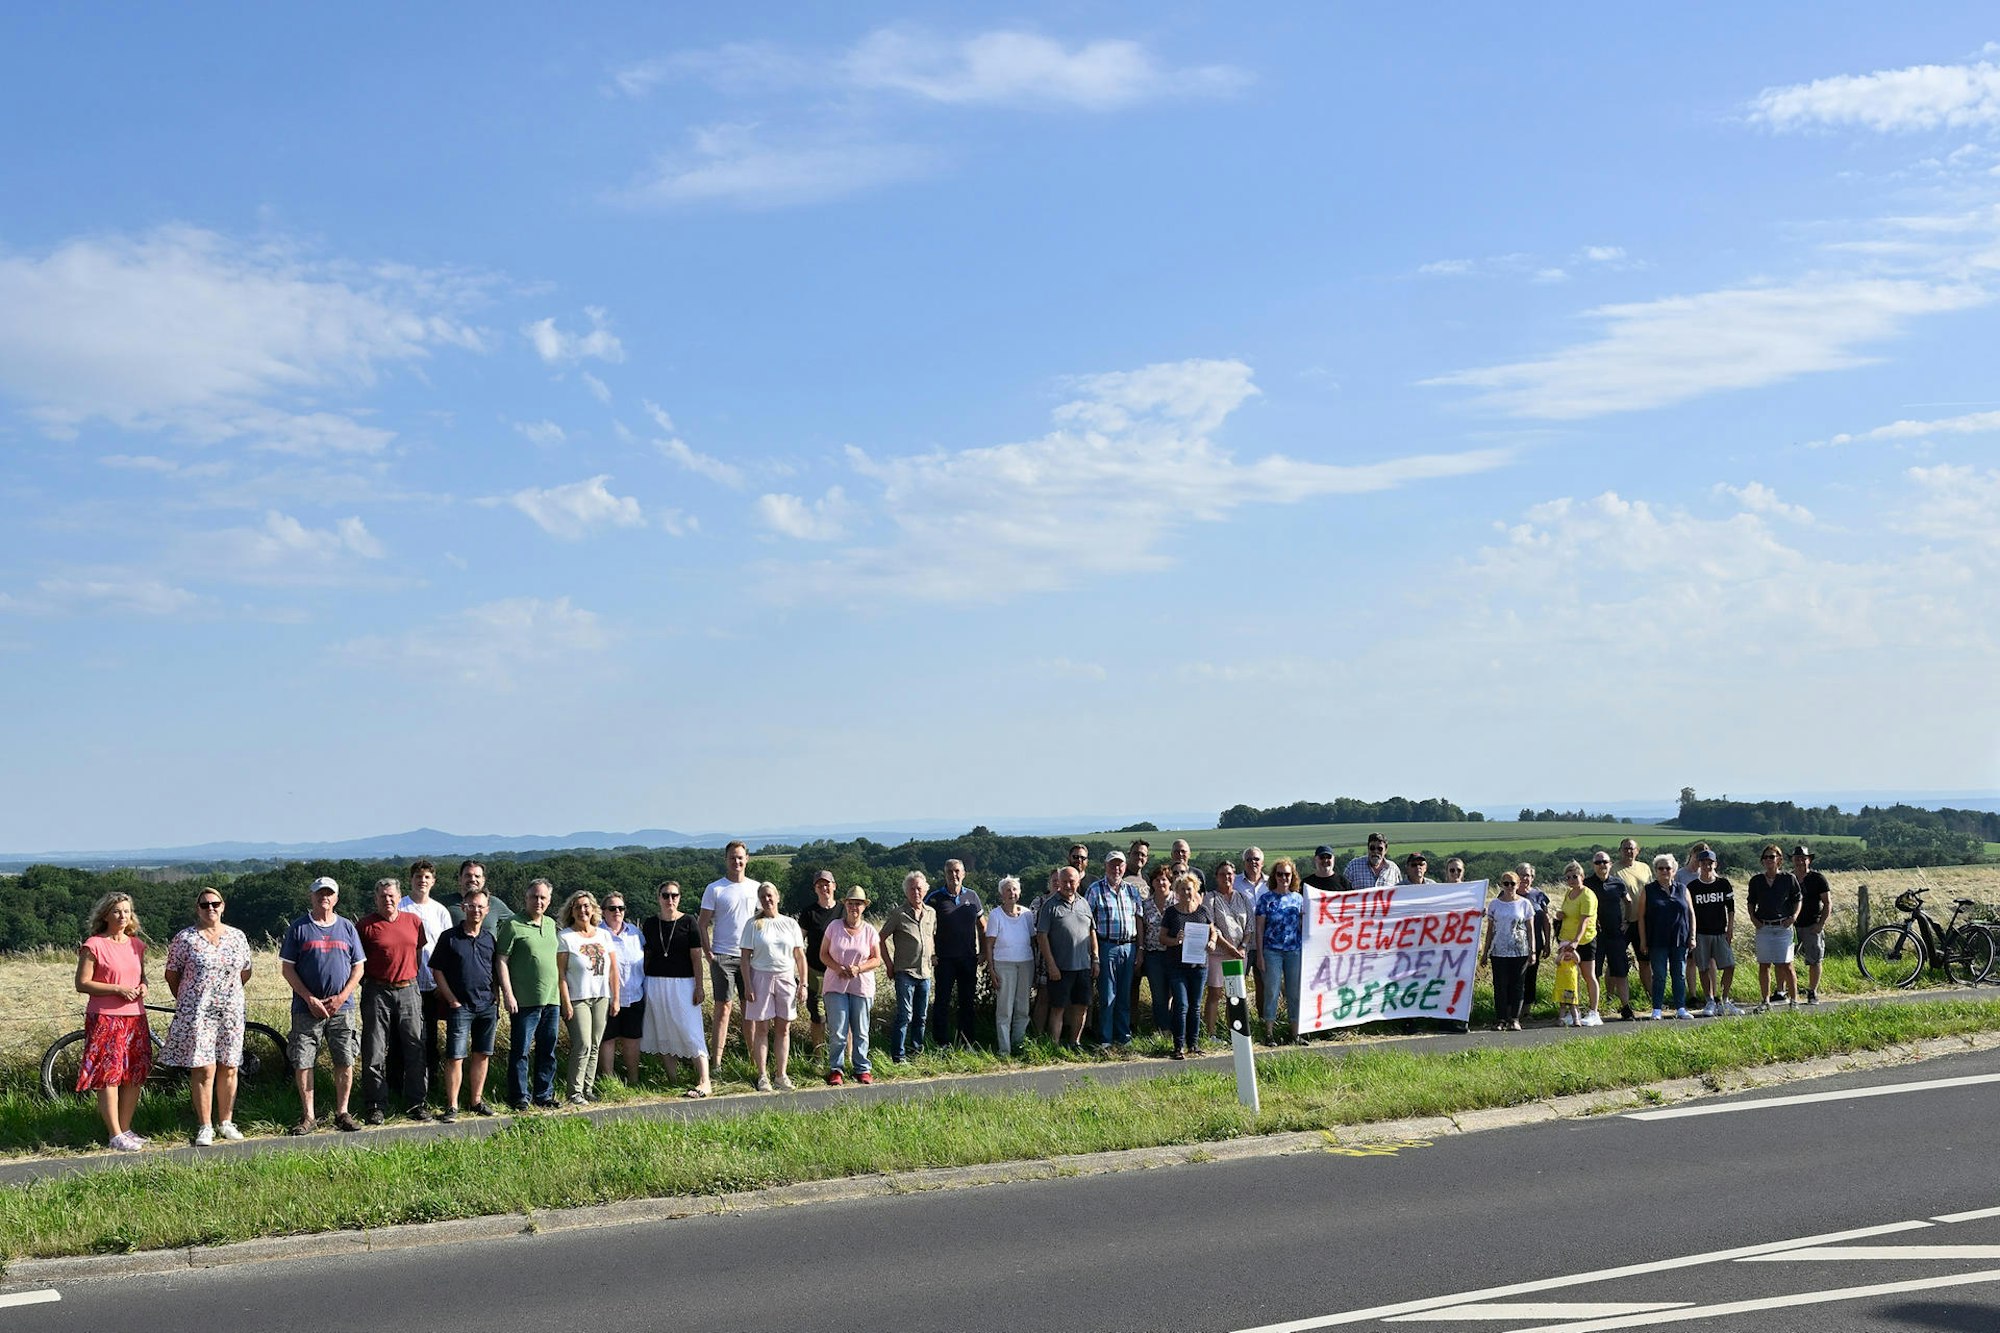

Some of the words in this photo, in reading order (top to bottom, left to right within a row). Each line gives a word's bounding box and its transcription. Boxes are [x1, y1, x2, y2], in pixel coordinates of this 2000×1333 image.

[1318, 889, 1395, 925] KEIN
[1695, 892, 1724, 904] RUSH
[1331, 909, 1482, 953] GEWERBE
[1309, 952, 1378, 991] AUF
[1388, 949, 1468, 981] DEM
